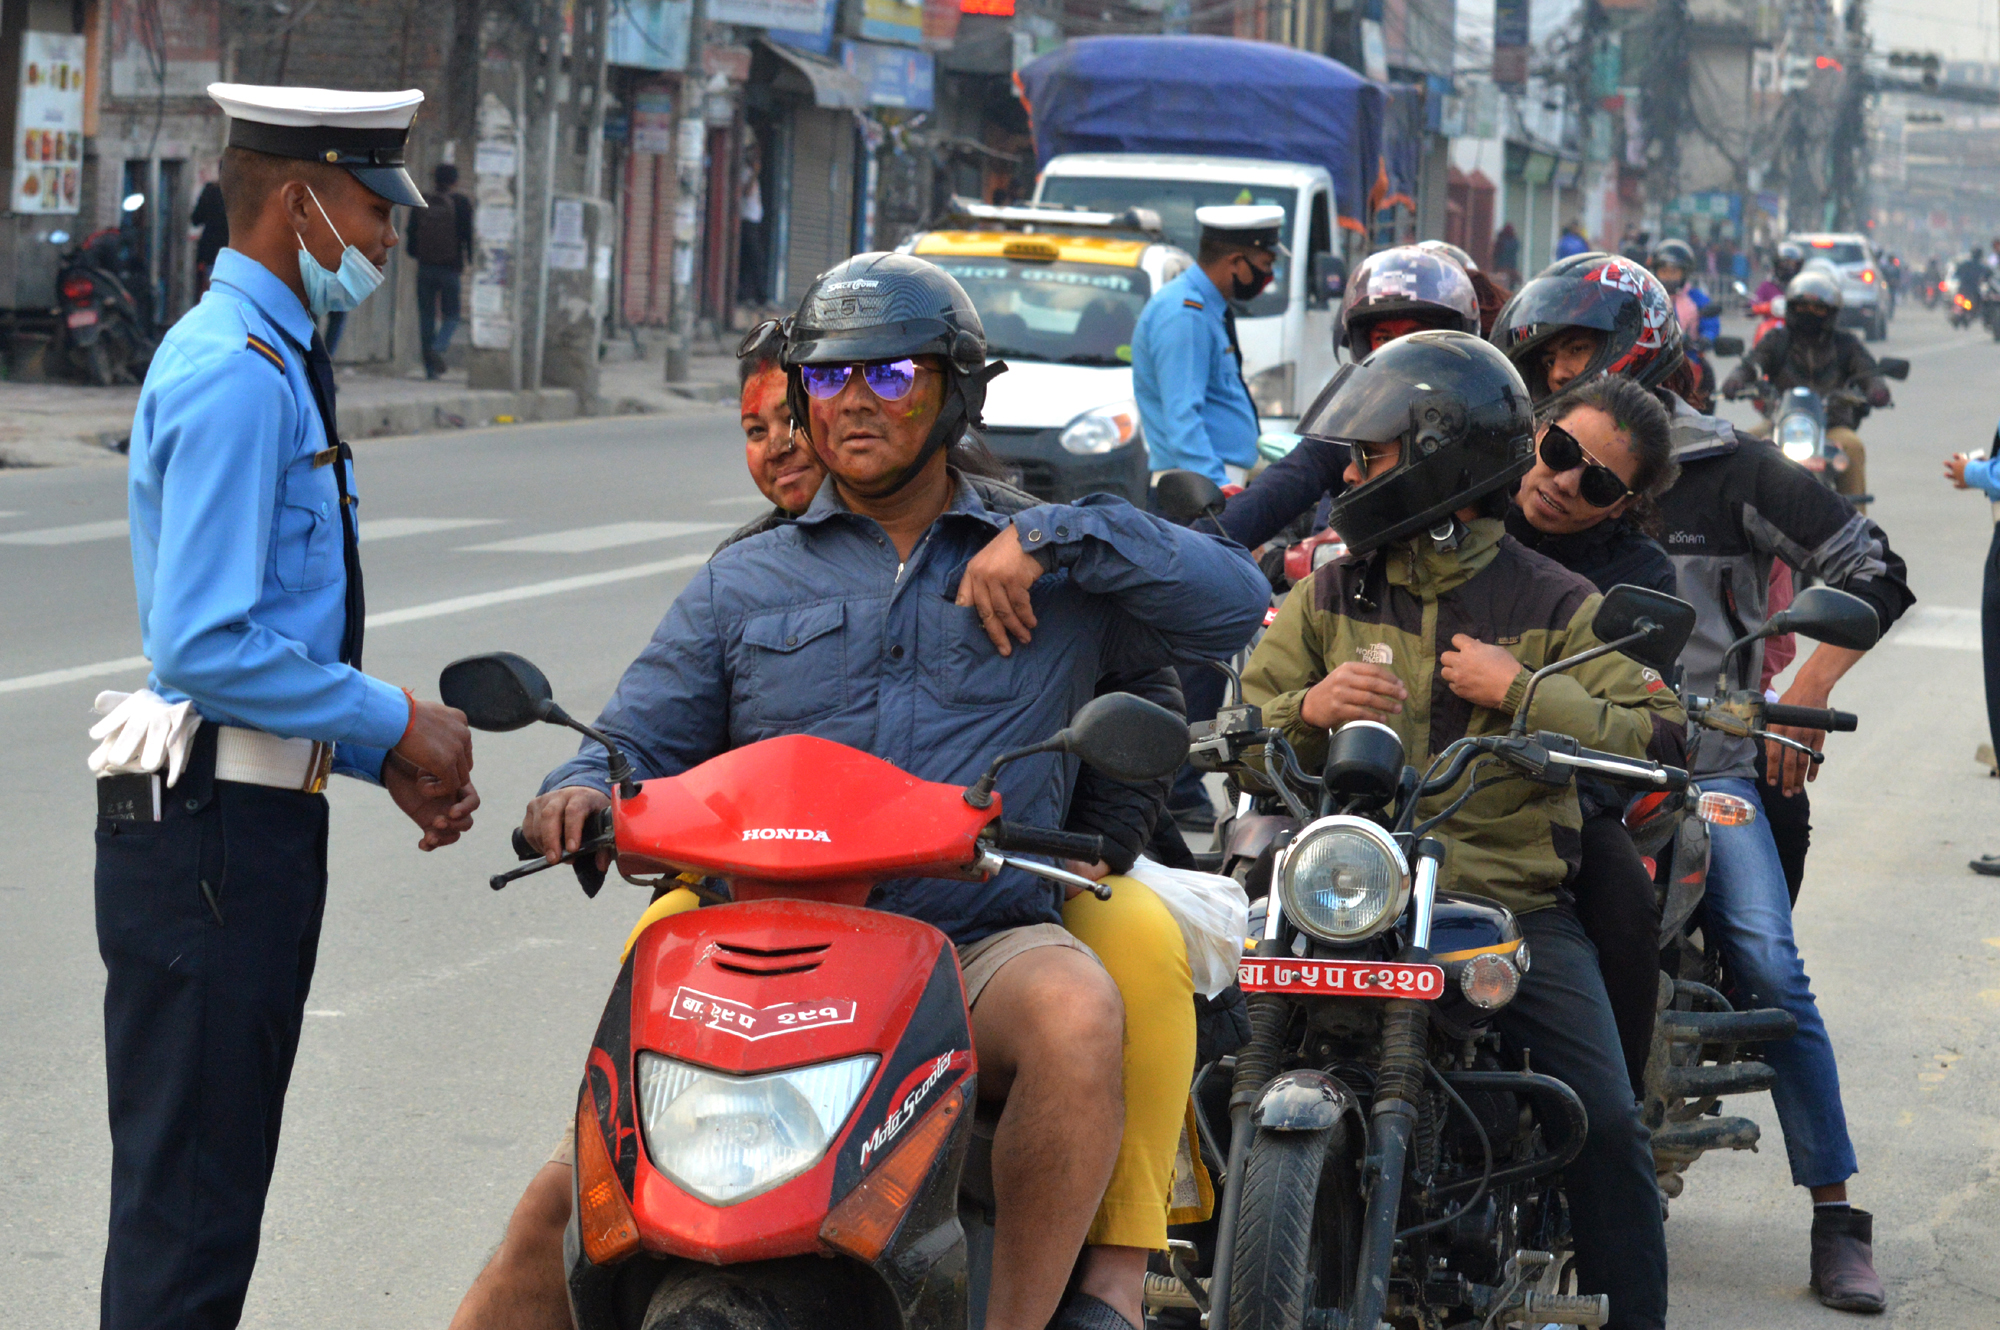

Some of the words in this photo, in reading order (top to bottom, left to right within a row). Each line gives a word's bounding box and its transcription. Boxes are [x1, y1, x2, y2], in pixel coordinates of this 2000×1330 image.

[742, 828, 832, 842] HONDA
[860, 1108, 903, 1166] Moto
[888, 1048, 955, 1141] Scooter
